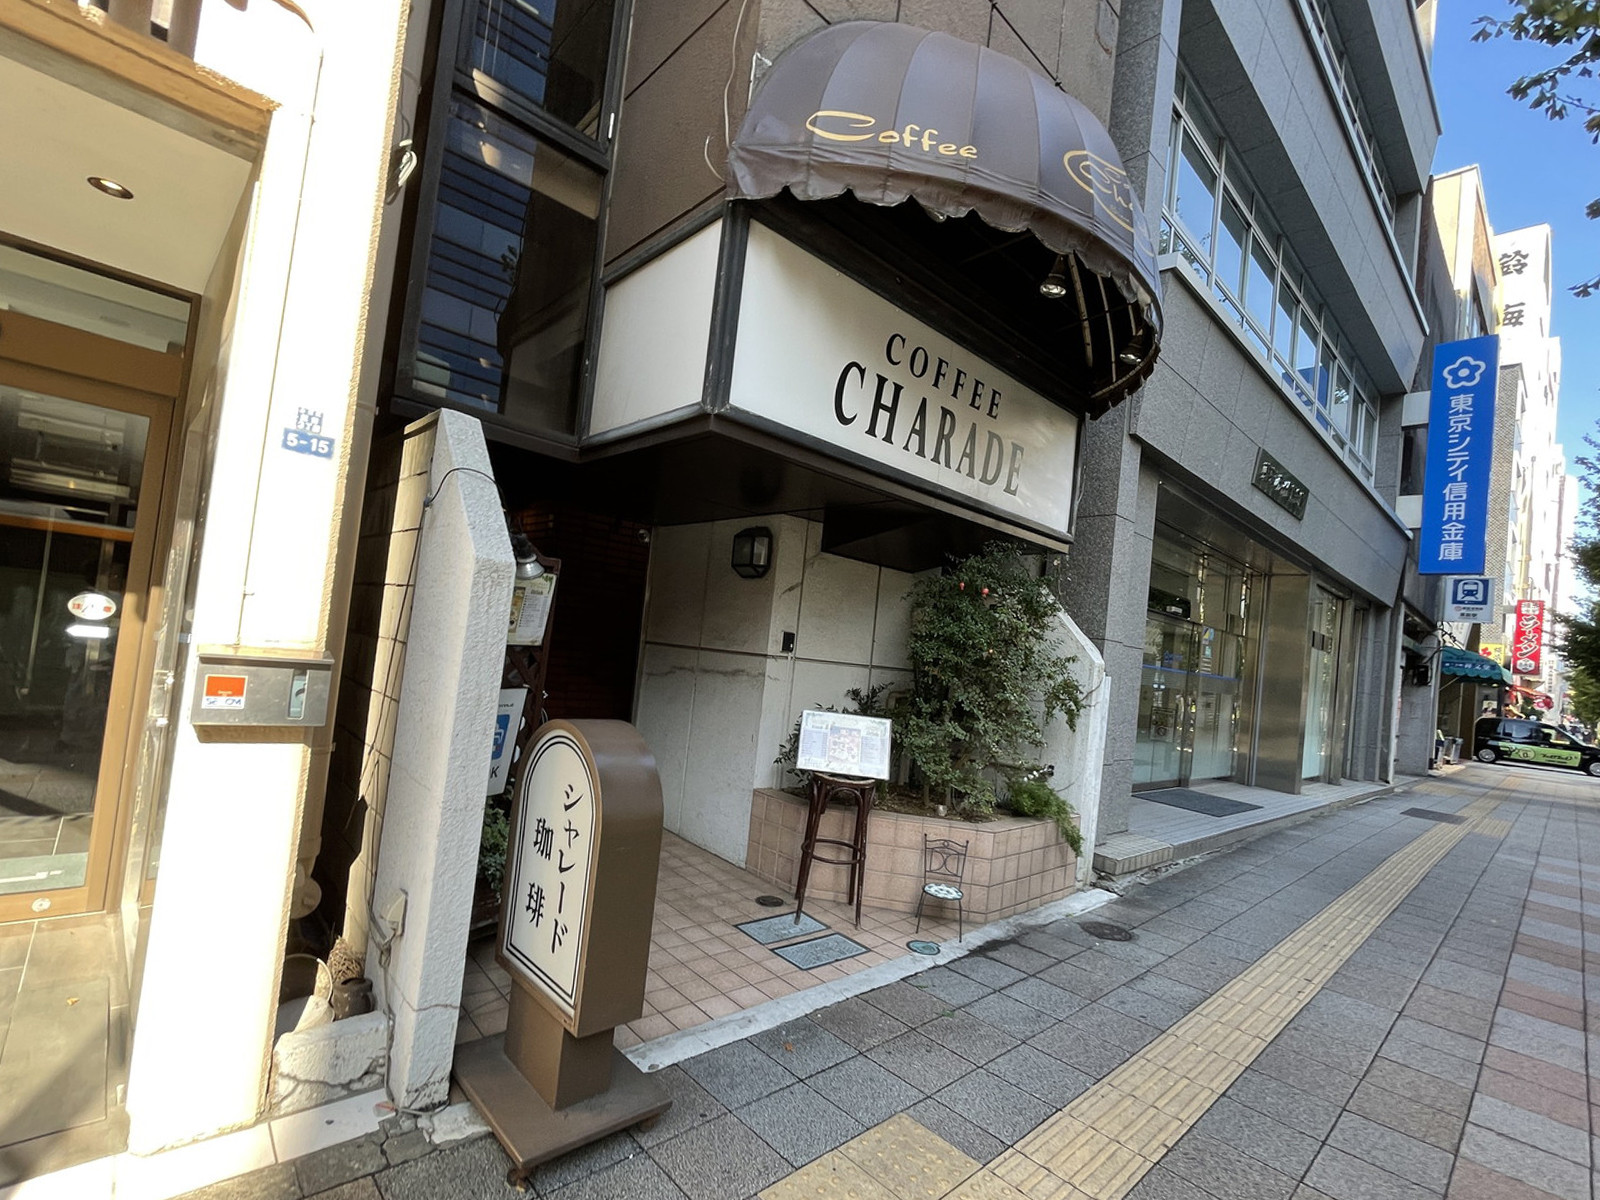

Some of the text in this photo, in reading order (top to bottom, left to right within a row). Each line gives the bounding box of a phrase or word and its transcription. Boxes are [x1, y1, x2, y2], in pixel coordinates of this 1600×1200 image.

[806, 111, 978, 159] Coffee
[834, 361, 1025, 496] CHARADE
[886, 333, 1002, 420] COFFEE
[286, 432, 329, 454] 5-15
[1438, 393, 1474, 561] 東京シティ信用金庫
[526, 818, 554, 928] 珈琲
[552, 784, 584, 954] シャレード
